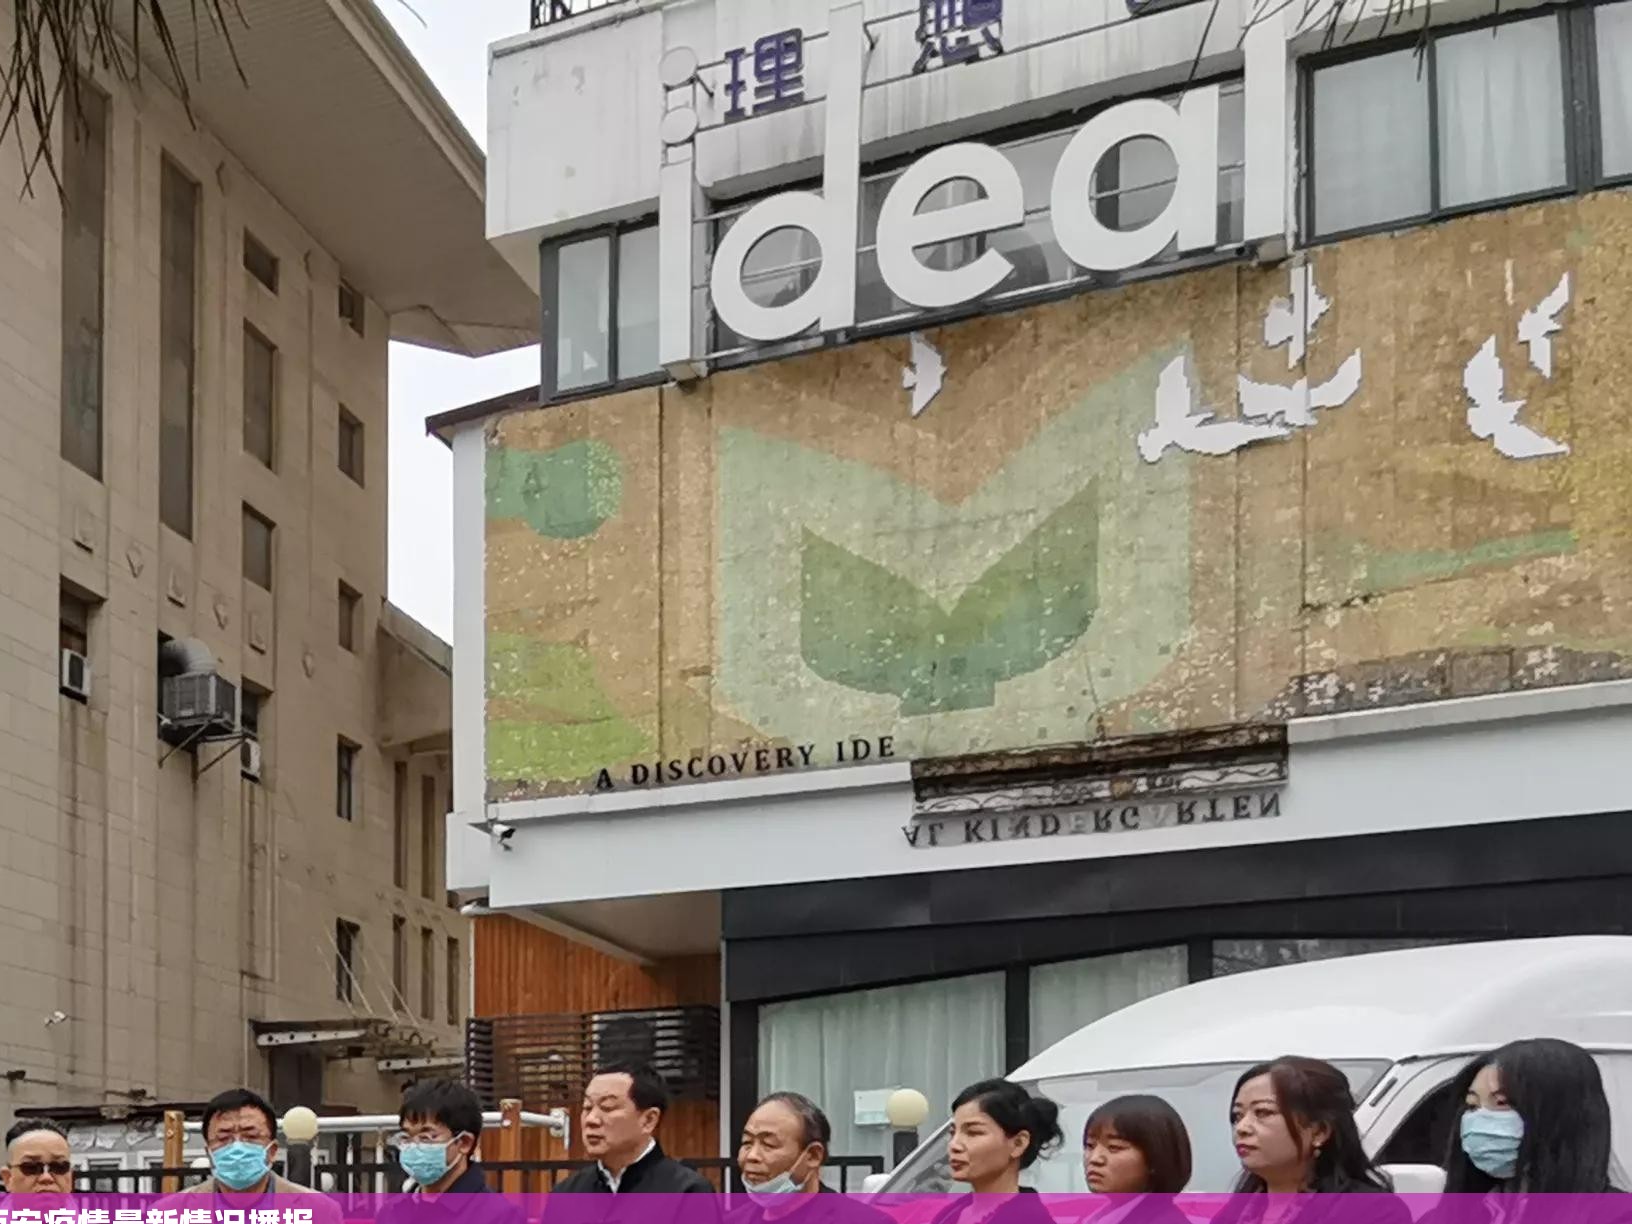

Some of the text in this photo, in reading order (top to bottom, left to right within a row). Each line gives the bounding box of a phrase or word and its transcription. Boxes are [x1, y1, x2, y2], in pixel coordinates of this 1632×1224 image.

[660, 0, 1288, 368] ideal
[595, 736, 895, 789] A DISCOVERY IDE
